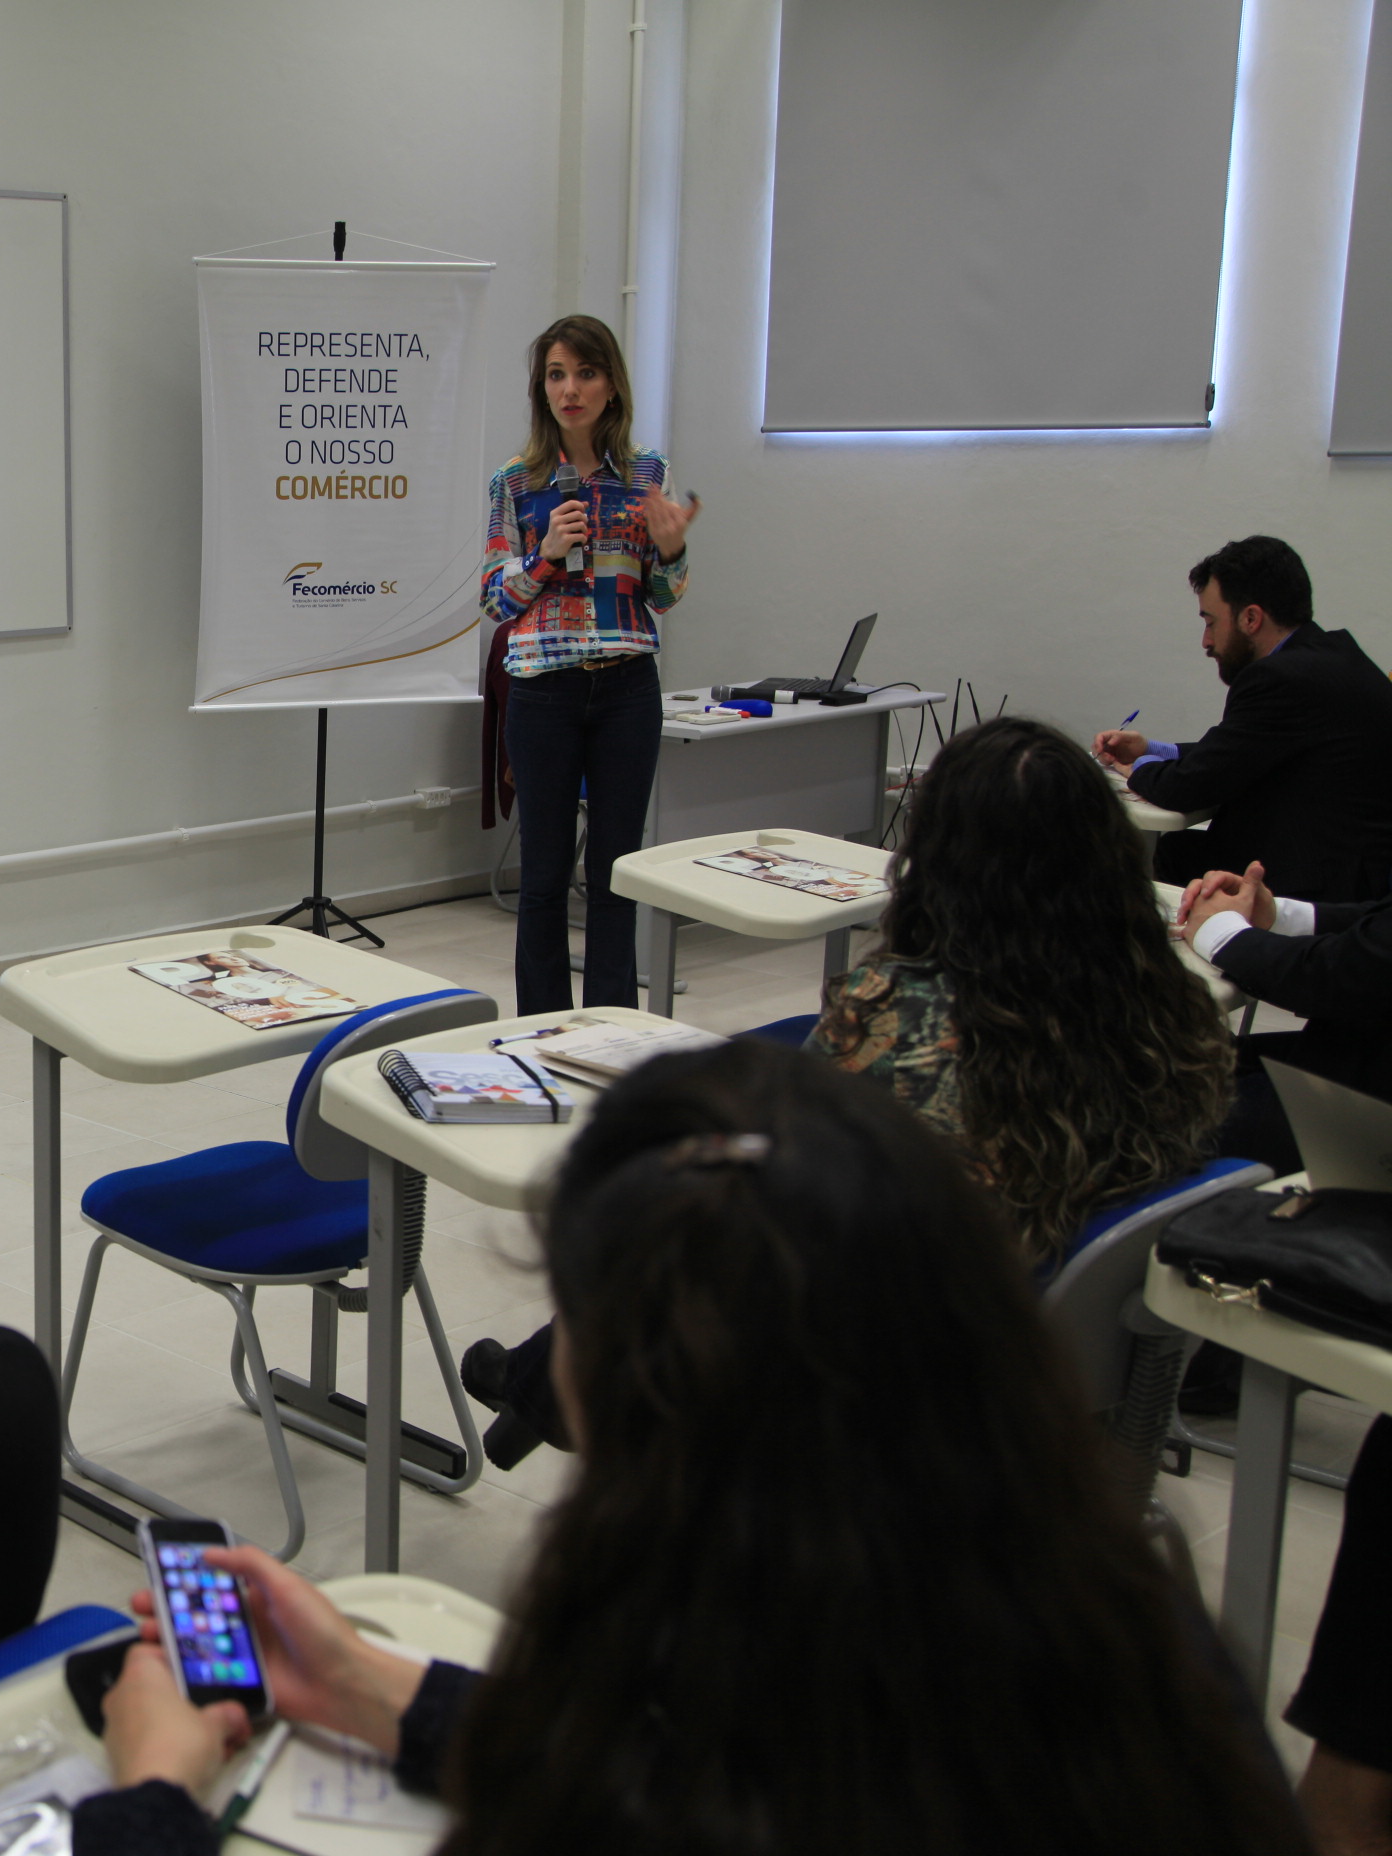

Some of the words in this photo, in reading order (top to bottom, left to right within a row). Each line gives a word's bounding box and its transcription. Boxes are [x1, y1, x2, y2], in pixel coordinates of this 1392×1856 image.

[258, 331, 430, 362] REPRESENTA,
[284, 367, 399, 394] DEFENDE
[279, 404, 293, 429] E
[301, 403, 409, 429] ORIENTA
[285, 439, 302, 465] O
[310, 439, 394, 465] NOSSO
[275, 469, 408, 501] COMÉRCIO
[292, 580, 376, 596] Fecomércio
[380, 580, 398, 595] SC
